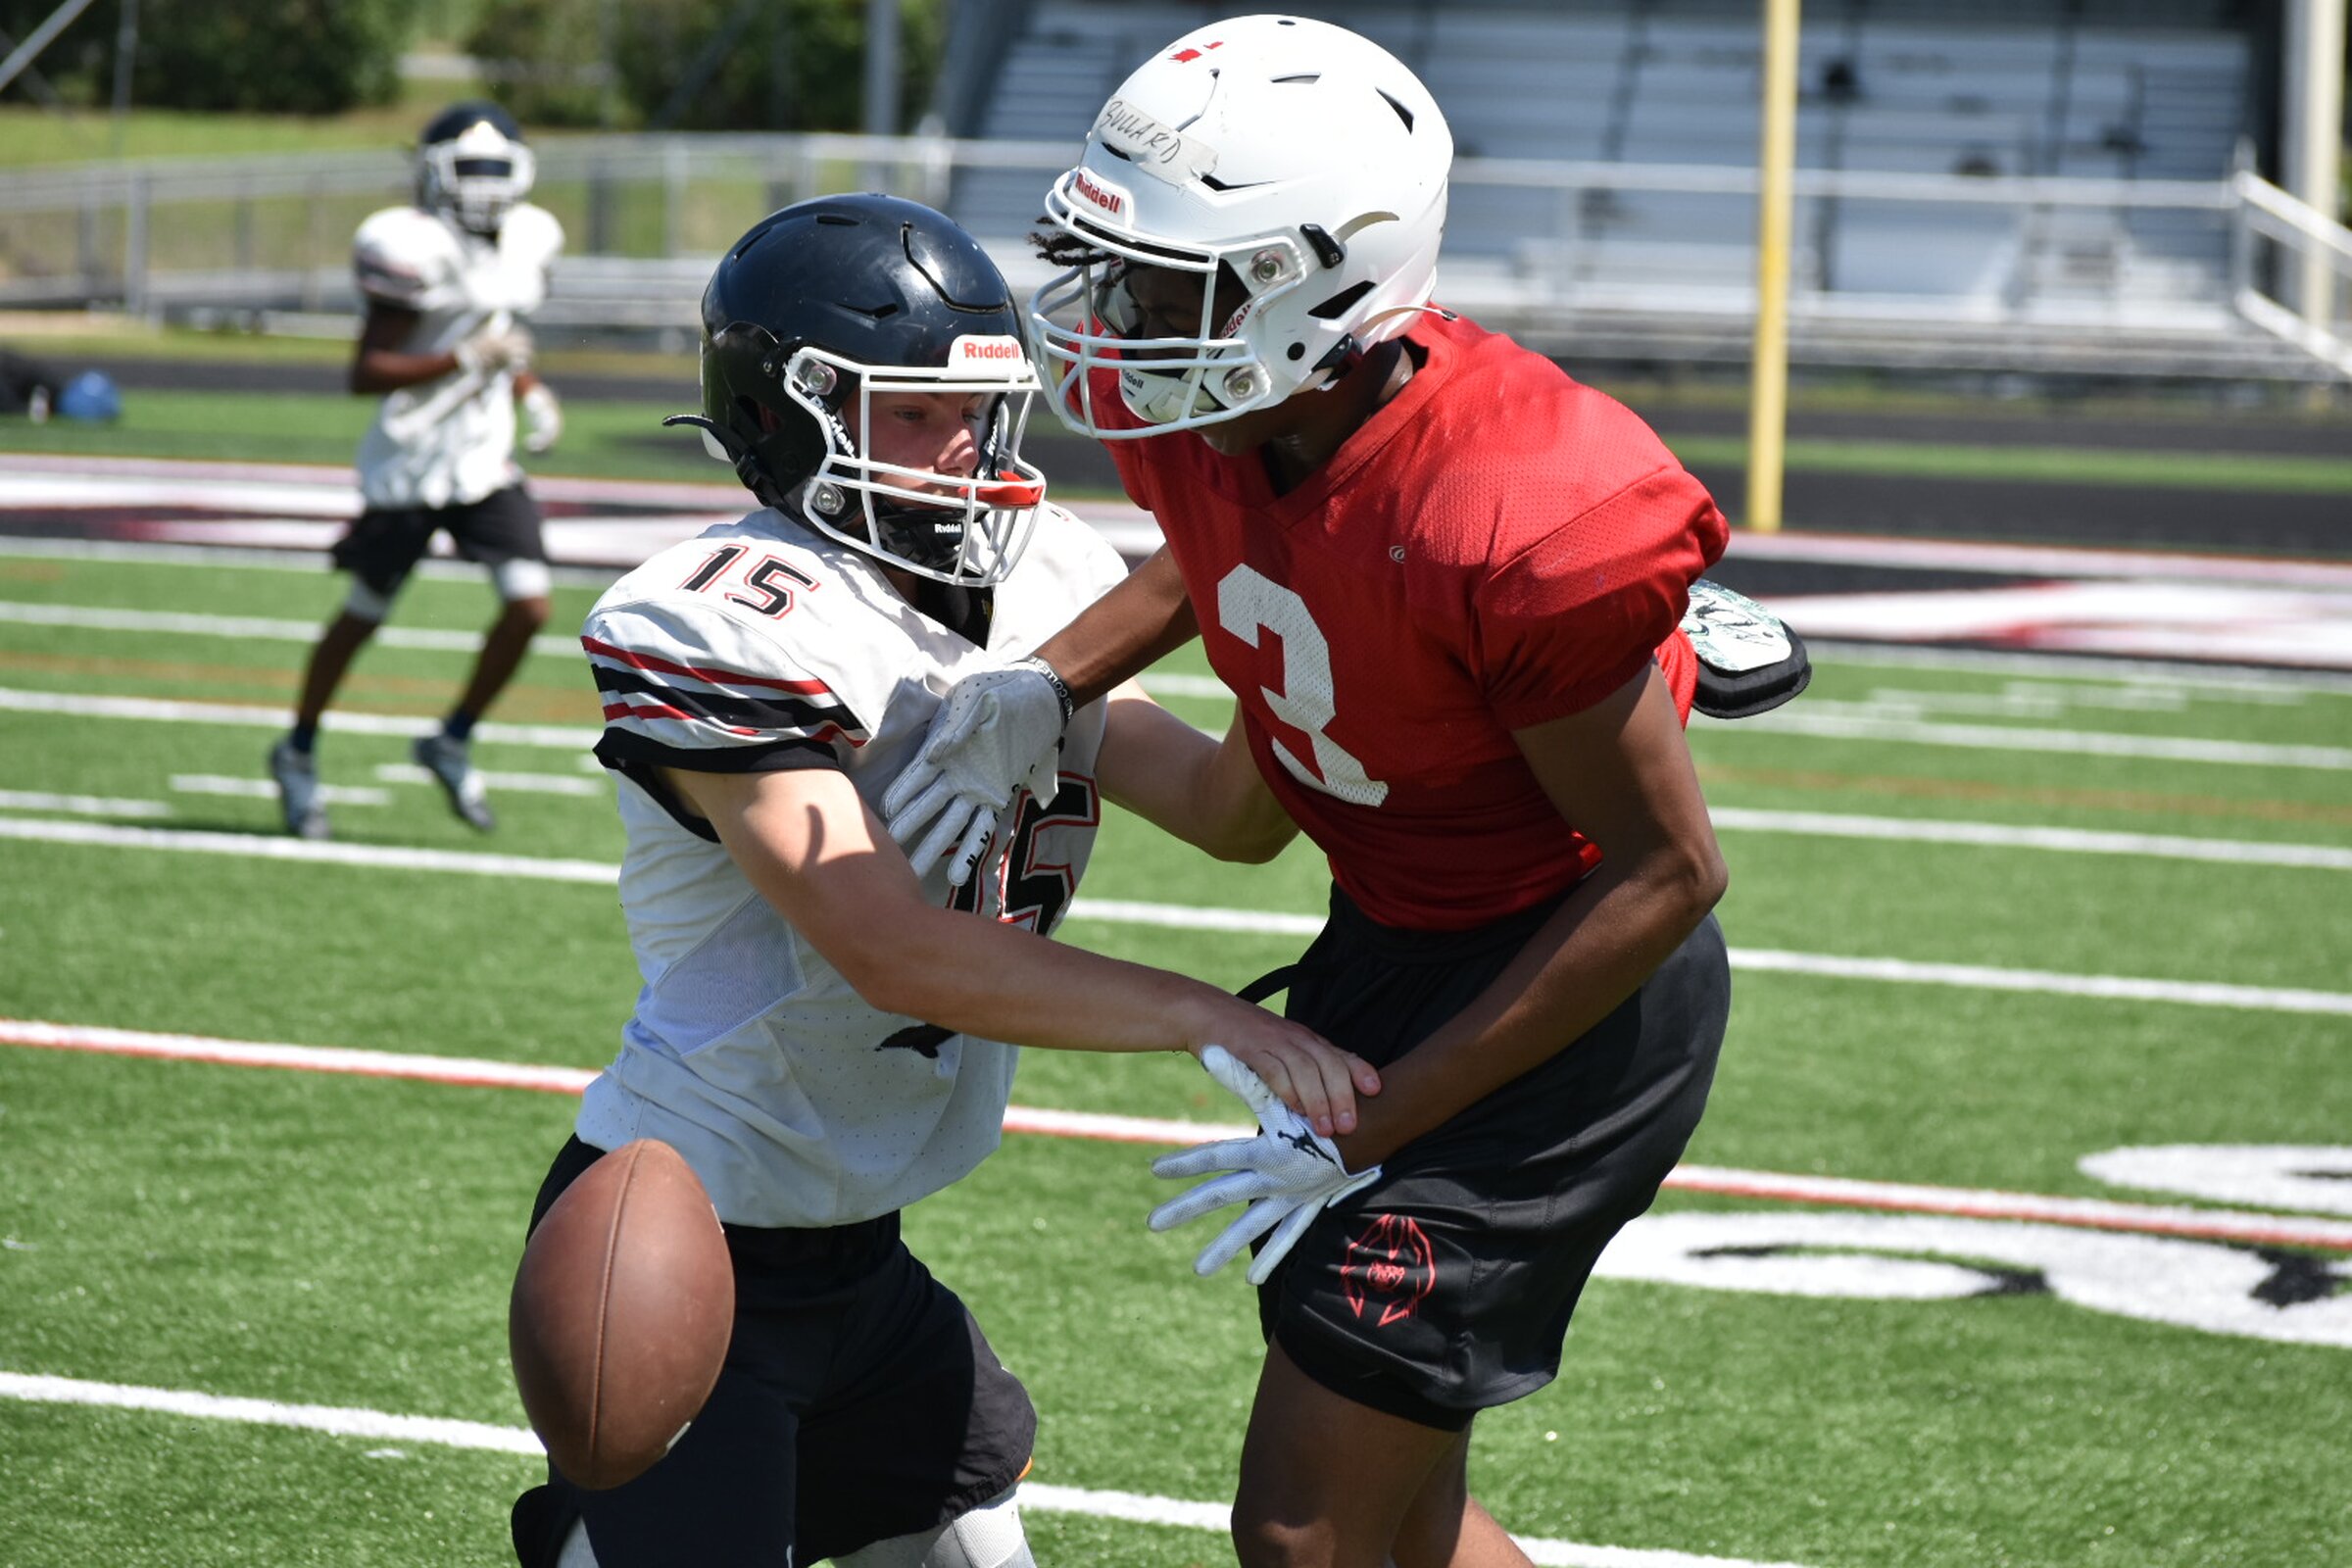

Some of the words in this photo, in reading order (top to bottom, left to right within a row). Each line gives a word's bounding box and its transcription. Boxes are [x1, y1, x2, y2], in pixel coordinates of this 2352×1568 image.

[1075, 172, 1121, 214] Riddell
[963, 342, 1020, 360] Riddell
[675, 543, 822, 620] 15
[1217, 563, 1390, 808] 3
